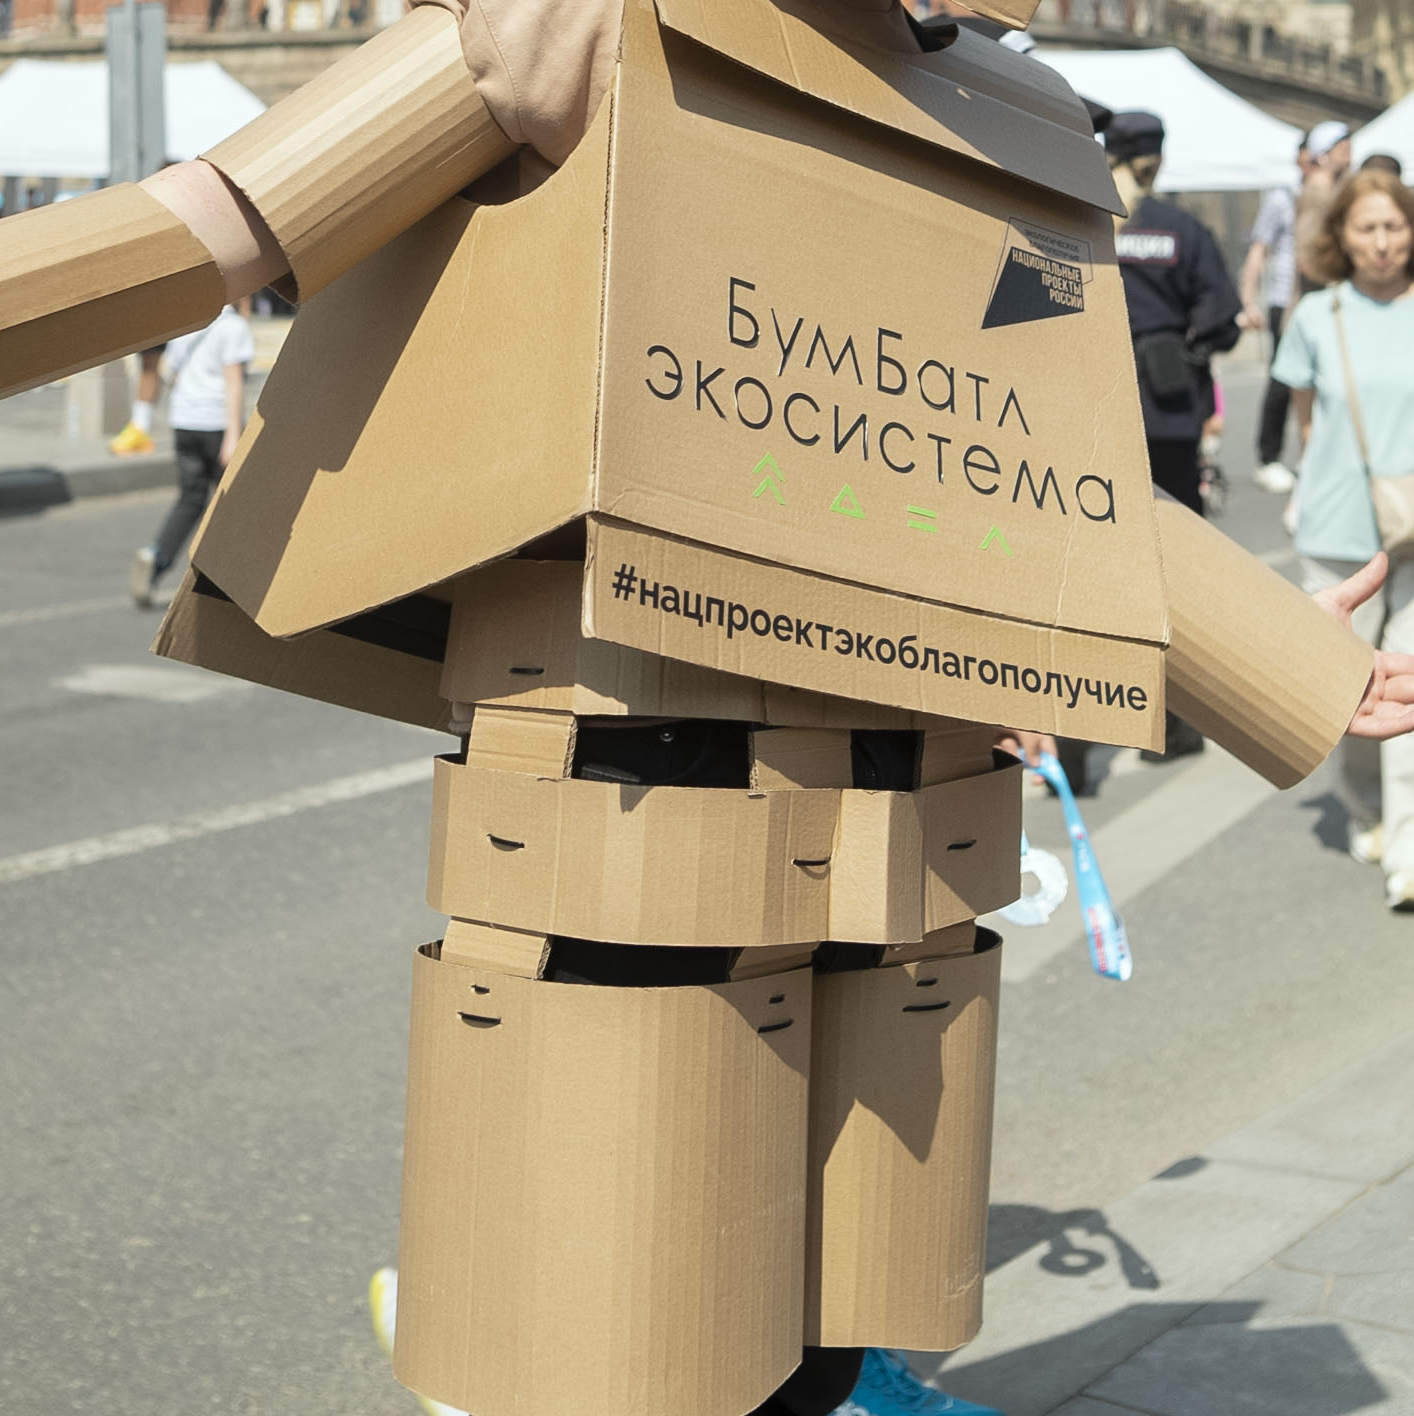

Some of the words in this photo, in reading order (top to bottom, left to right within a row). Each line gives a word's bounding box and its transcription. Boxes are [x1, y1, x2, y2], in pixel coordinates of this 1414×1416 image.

[1012, 249, 1081, 282] НАЦИОНАЛЬНЫЕ
[1041, 272, 1082, 296] ПРОЕКТЫ
[1050, 288, 1083, 309] РОССИИ
[728, 275, 1030, 436] БумБатл
[645, 344, 1117, 524] экосистема
[611, 562, 1148, 712] #нацпроектэкоблагополучие
